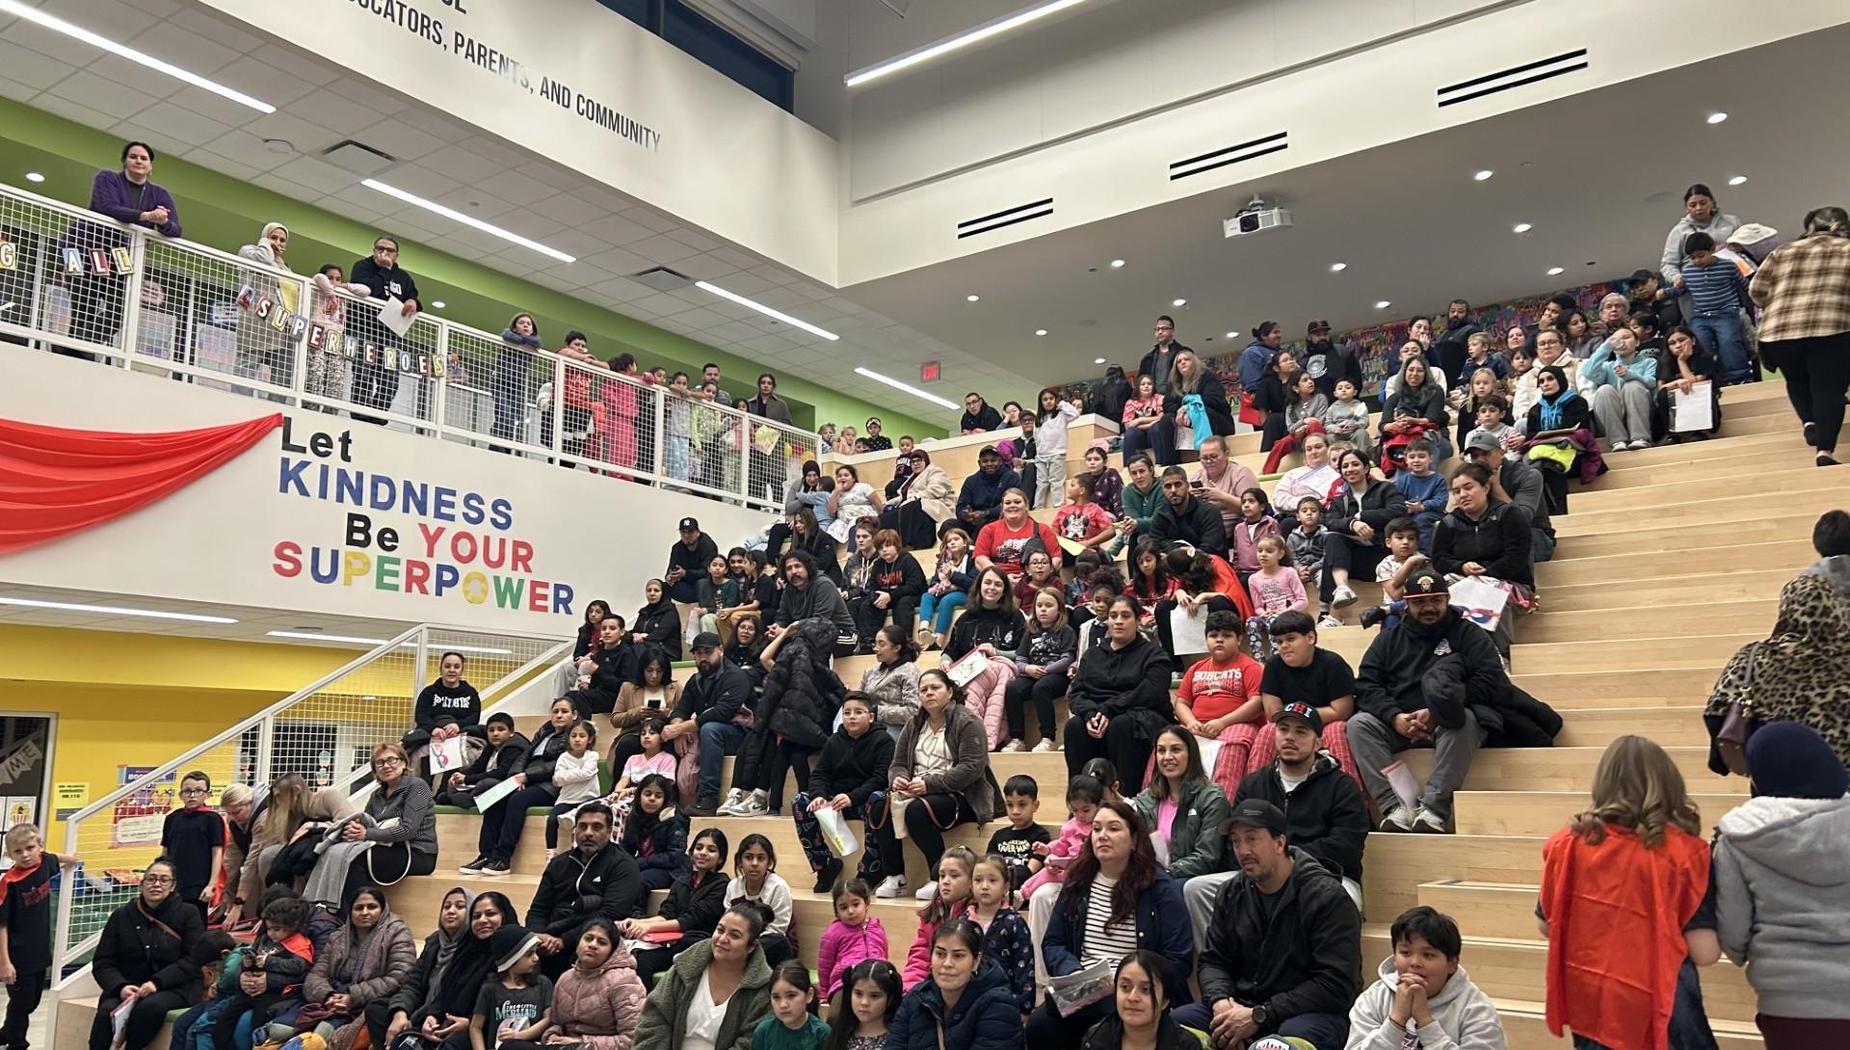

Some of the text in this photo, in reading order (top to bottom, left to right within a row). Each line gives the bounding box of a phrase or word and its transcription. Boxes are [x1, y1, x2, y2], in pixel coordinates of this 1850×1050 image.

[453, 31, 534, 94] PARENTS,
[540, 76, 571, 109] AND
[576, 93, 661, 152] COMMUNITY
[67, 249, 133, 275] ALL
[256, 299, 444, 376] SUPERHEROES
[281, 416, 352, 462] Let
[279, 457, 513, 530] KINDNESS
[345, 512, 534, 573] Be YOUR
[272, 541, 574, 615] SUPERPOWER
[1193, 668, 1242, 681] BOBCATS
[1284, 702, 1313, 718] CHI
